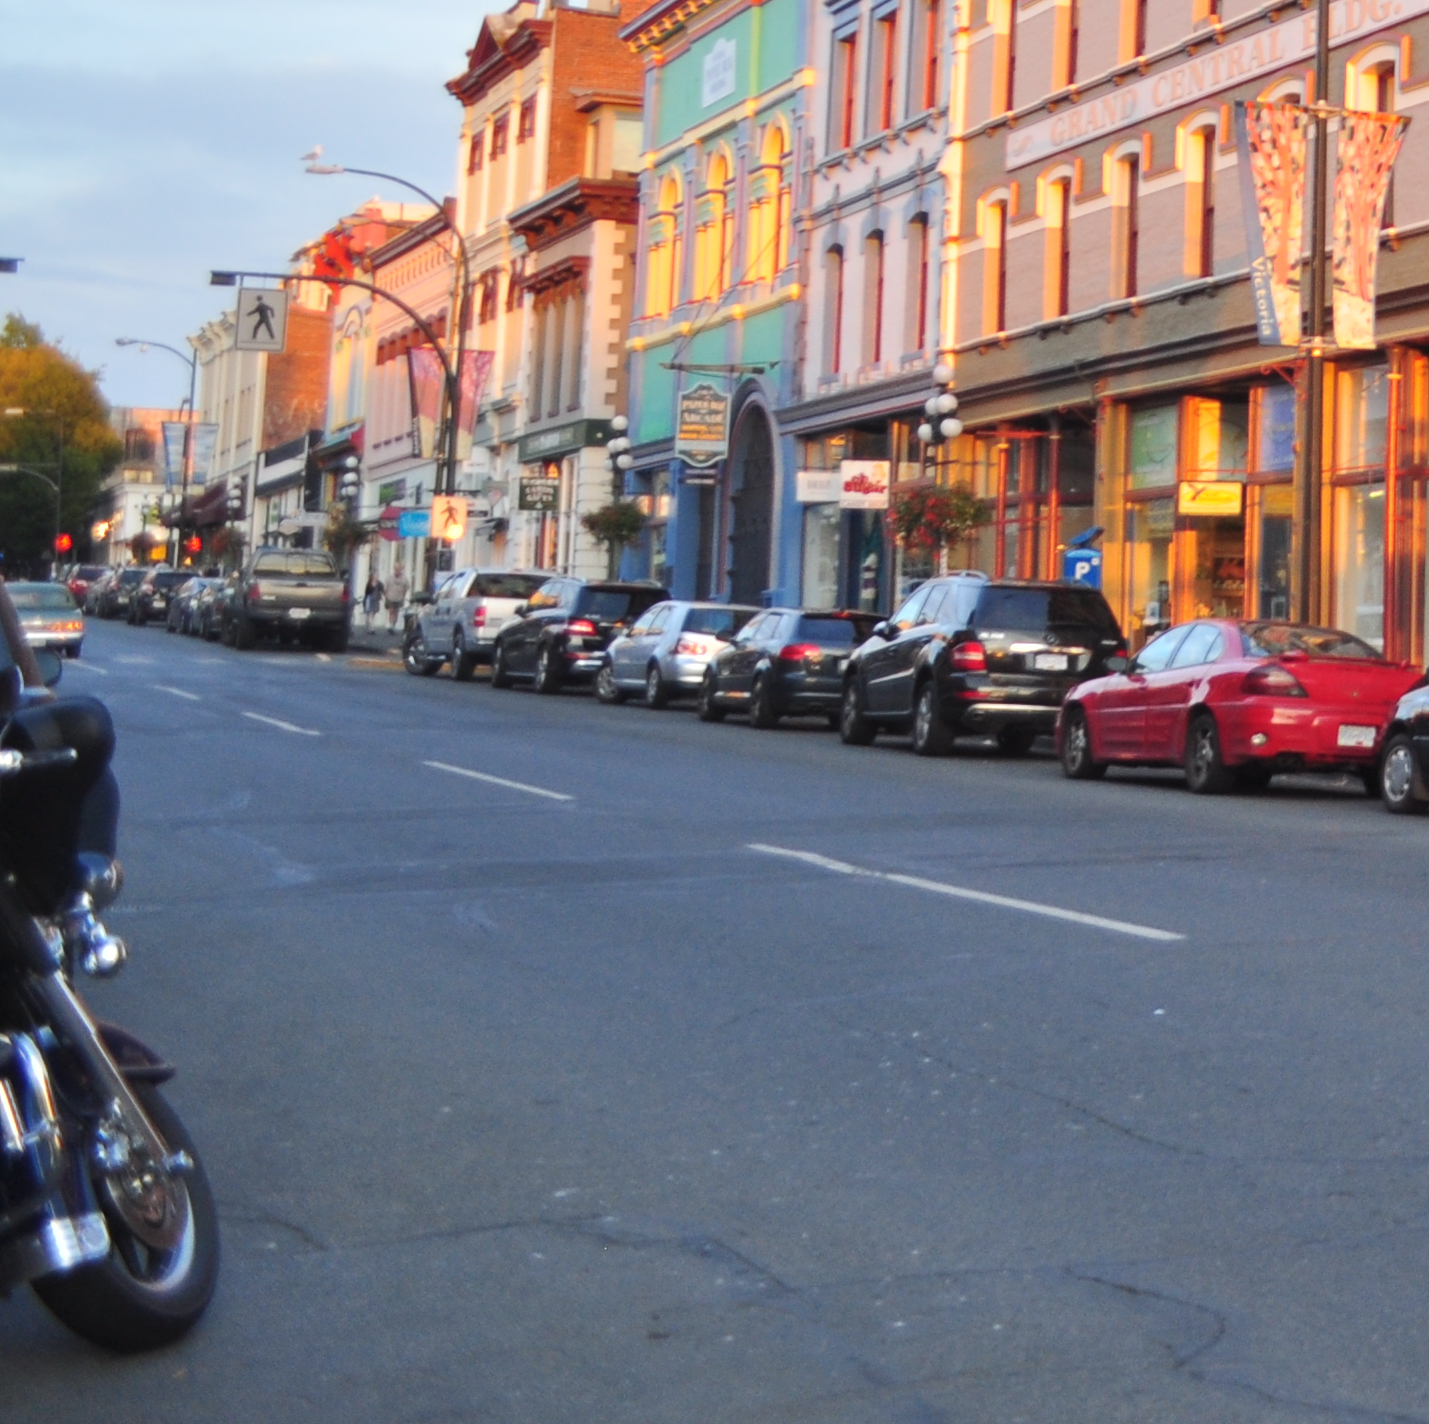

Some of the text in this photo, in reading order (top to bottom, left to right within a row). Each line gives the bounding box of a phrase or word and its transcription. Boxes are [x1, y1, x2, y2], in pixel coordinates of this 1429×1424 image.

[1050, 89, 1137, 146] GRAND
[1151, 29, 1285, 107] CENTRAL
[1252, 256, 1274, 336] Victoria
[1075, 561, 1091, 580] P
